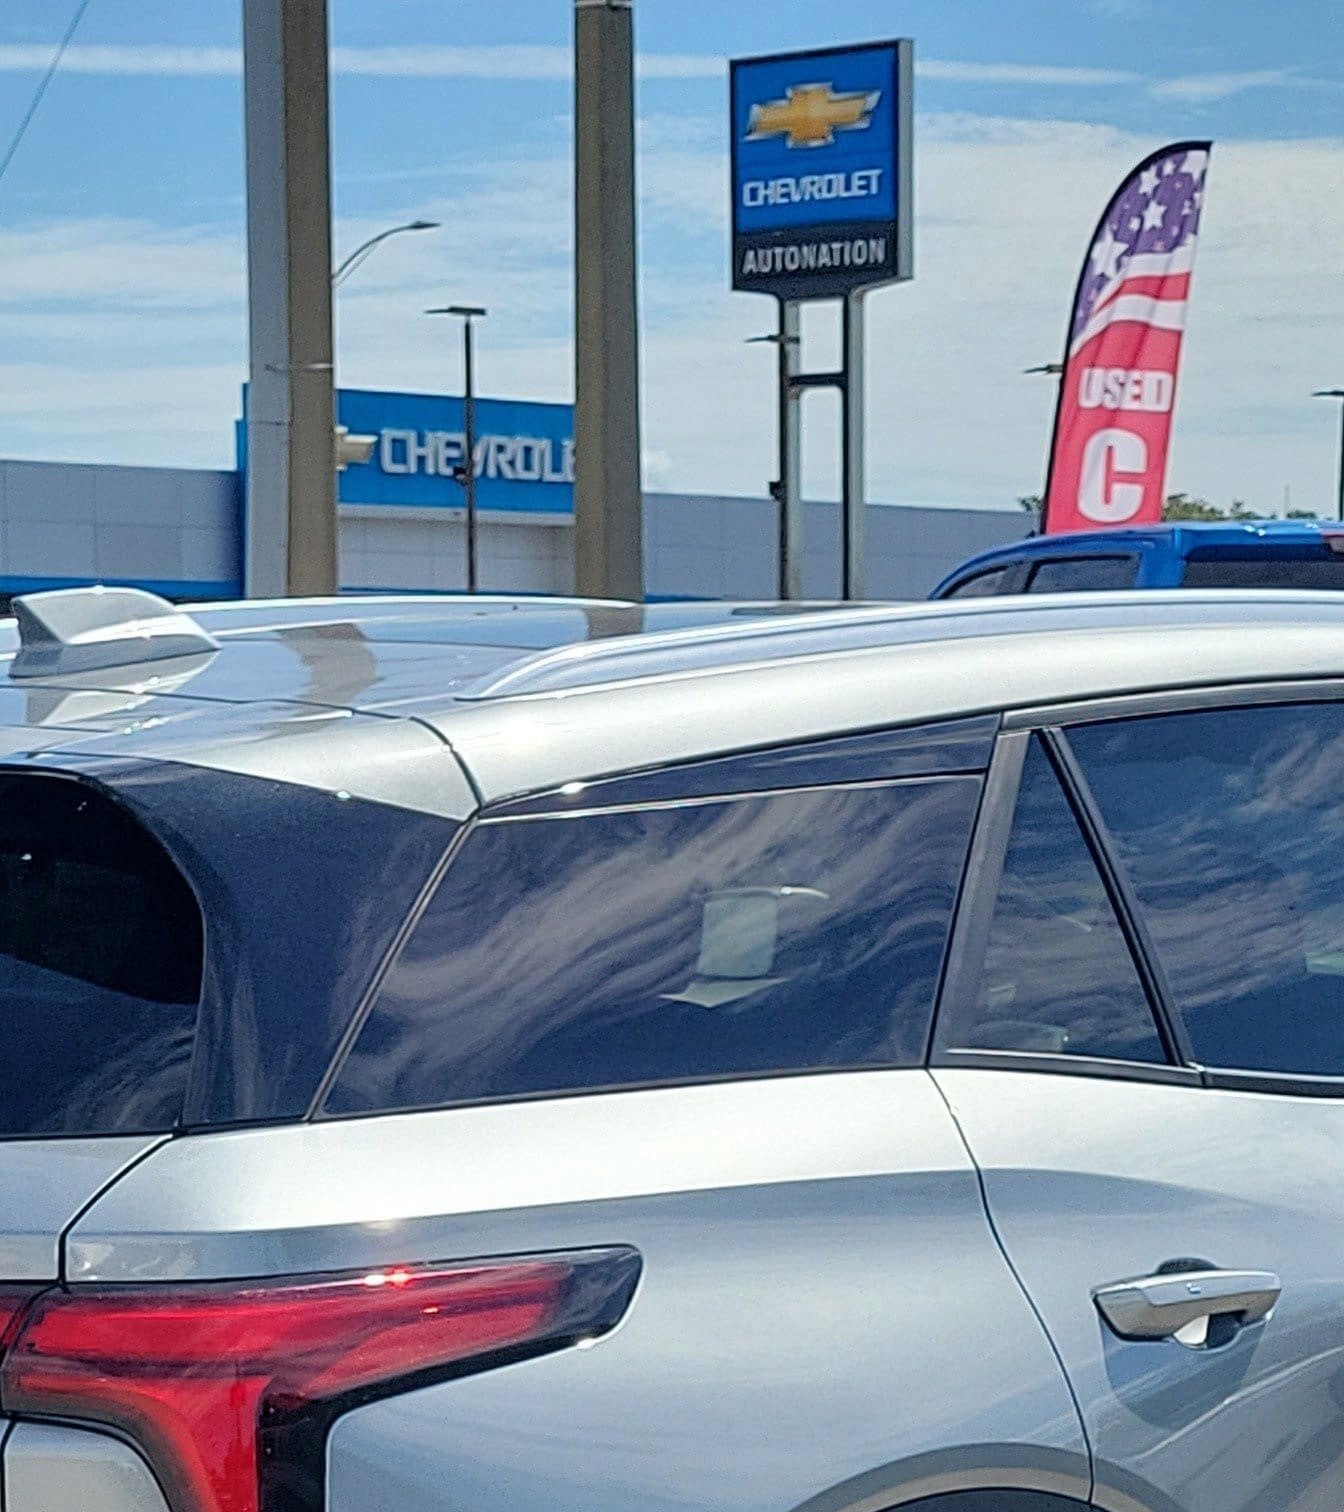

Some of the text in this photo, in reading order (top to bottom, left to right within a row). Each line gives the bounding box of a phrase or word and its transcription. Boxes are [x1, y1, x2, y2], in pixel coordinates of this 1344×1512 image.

[742, 168, 883, 208] CHEVROLET
[742, 239, 887, 274] AUTONATION
[1078, 367, 1174, 413] USED
